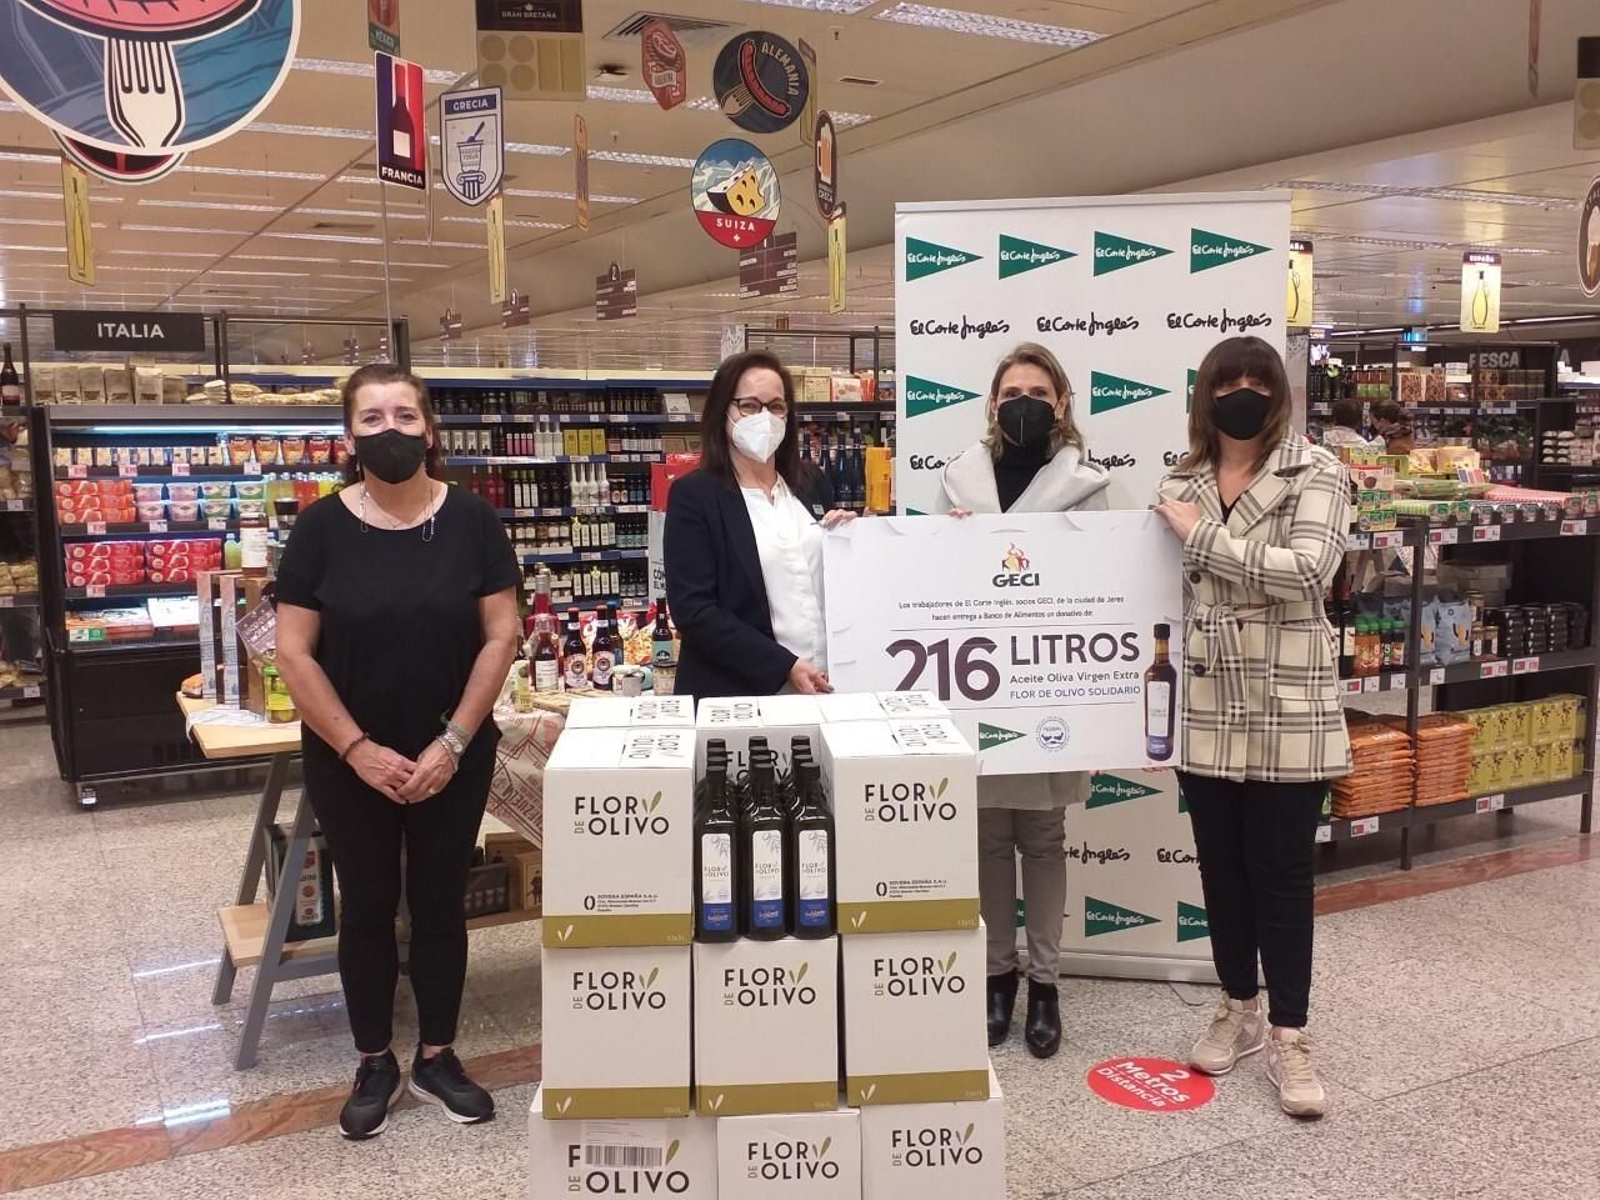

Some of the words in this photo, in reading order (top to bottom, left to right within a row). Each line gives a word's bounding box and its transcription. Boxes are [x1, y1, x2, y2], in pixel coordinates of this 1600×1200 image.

[761, 41, 799, 96] ALEMANIA
[453, 98, 489, 111] GRECIA
[381, 165, 424, 187] FRANCIA
[716, 217, 756, 232] SUIZA
[1001, 250, 1009, 261] El
[1009, 251, 1030, 261] Corte
[1030, 248, 1060, 263] Inglés
[1096, 248, 1105, 257] El
[1105, 249, 1126, 257] Corte
[1126, 245, 1156, 260] Inglés
[1192, 245, 1201, 255] El
[1202, 246, 1223, 255] Corte
[1223, 242, 1255, 257] Inglés
[1290, 241, 1304, 251] AÑA
[907, 252, 916, 263] El
[916, 253, 937, 263] Corte
[937, 251, 966, 266] Inglés
[97, 323, 165, 338] ITALIA
[910, 320, 925, 335] El
[925, 320, 959, 335] Corte
[960, 315, 1010, 340] Inglés
[1037, 316, 1051, 332] El
[1052, 317, 1086, 332] Corte
[1089, 312, 1139, 336] Inglés
[1167, 313, 1182, 329] El
[1183, 313, 1218, 328] Corte
[1220, 309, 1272, 333] Inglés
[907, 390, 916, 400] El
[916, 391, 935, 400] Corte
[935, 388, 965, 403] Inglés
[1092, 387, 1101, 396] El
[1101, 387, 1122, 396] Corte
[1122, 384, 1152, 400] Inglés
[910, 455, 924, 470] El
[992, 573, 1040, 588] GECI
[912, 600, 952, 610] trabajadores
[973, 599, 992, 607] Corte
[1074, 596, 1095, 604] ciudad
[932, 613, 951, 621] hacen
[953, 613, 977, 622] entrega
[984, 612, 1003, 620] Banco
[1014, 610, 1045, 618] Alimentos
[1011, 632, 1140, 666] LITROS
[885, 637, 1001, 701] 216
[1010, 674, 1044, 684] Aceite
[1047, 673, 1074, 683] Oliva
[1077, 672, 1110, 682] Virgen
[1113, 671, 1140, 680] Extra
[1010, 689, 1036, 699] FLOR
[1038, 689, 1052, 698] DE
[1054, 688, 1086, 698] OLIVO
[1088, 685, 1141, 697] SOLIDARIO
[865, 783, 925, 802] FLOR
[1096, 784, 1116, 794] Corte
[1116, 782, 1146, 797] Inglés
[575, 796, 638, 815] FLOR
[865, 808, 875, 821] DE
[878, 803, 957, 822] OLIVO
[574, 820, 585, 834] DE
[588, 816, 669, 836] OLIVO
[1081, 841, 1130, 864] Inglés
[1157, 848, 1172, 863] El
[1086, 911, 1095, 921] El
[1095, 911, 1115, 922] Corte
[1115, 911, 1145, 925] Inglés
[1179, 917, 1187, 926] El
[874, 957, 934, 977] FLOR
[573, 972, 635, 991] FLOR
[725, 968, 785, 987] FLOR
[875, 983, 884, 996] DE
[888, 976, 965, 997] OLIVO
[573, 997, 583, 1009] DE
[587, 991, 666, 1011] OLIVO
[724, 993, 735, 1006] DE
[738, 987, 816, 1007] OLIVO
[1116, 1061, 1190, 1102] Metros
[1160, 1069, 1191, 1082] 2
[1097, 1067, 1166, 1107] Distancia
[892, 1129, 951, 1147] FLOR
[748, 1141, 808, 1160] FLOR
[892, 1152, 902, 1166] DE
[905, 1147, 983, 1167] OLIVO
[748, 1166, 758, 1179] DE
[761, 1161, 839, 1180] OLIVO
[568, 1176, 581, 1192] DE
[586, 1171, 690, 1194] OLIVO
